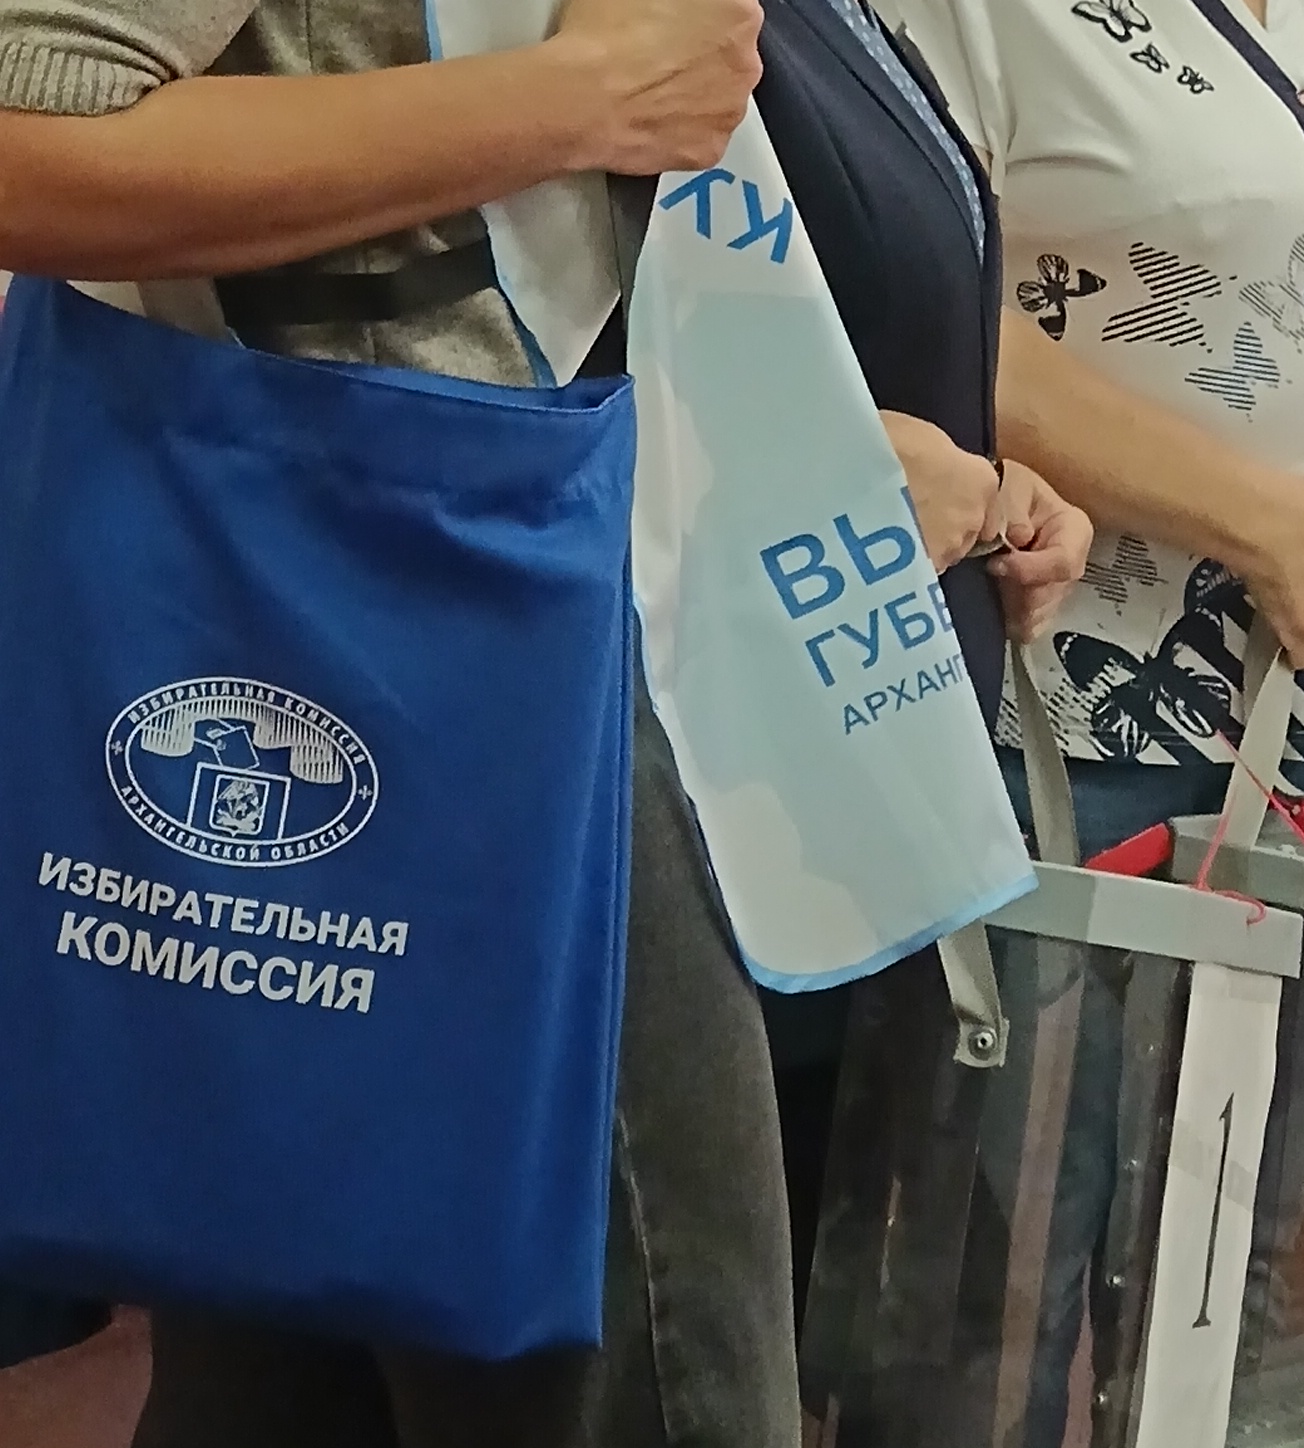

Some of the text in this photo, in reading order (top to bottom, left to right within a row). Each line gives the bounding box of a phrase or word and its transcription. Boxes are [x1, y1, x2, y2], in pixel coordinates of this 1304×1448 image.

[127, 680, 367, 765] ИЗБИРАТЕЛЬНАЯ КОМИССИЯ
[120, 784, 350, 861] АРХАНГЕЛЬСКОЙ ОБЛАСТИ
[37, 851, 410, 957] ИЗБИРАТЕЛЬНАЯ
[55, 910, 376, 1014] КОМИССИЯ
[1191, 1091, 1235, 1329] 1
